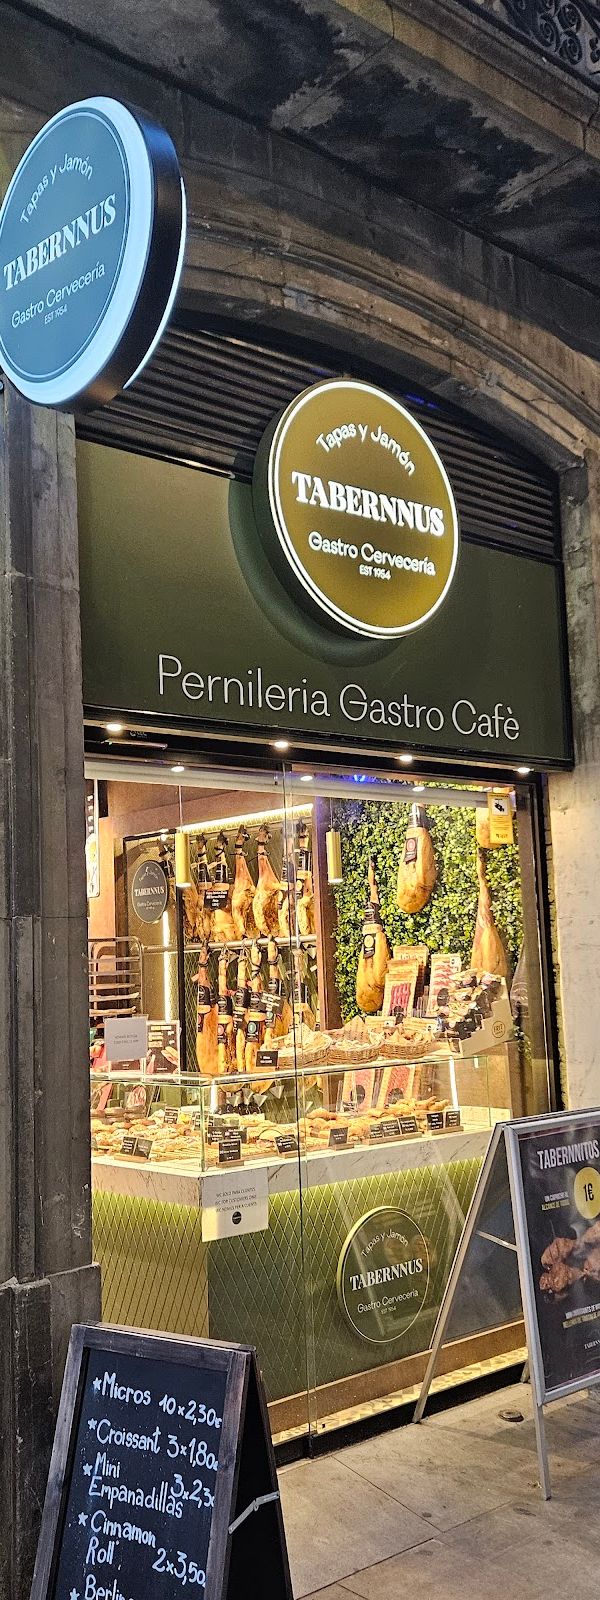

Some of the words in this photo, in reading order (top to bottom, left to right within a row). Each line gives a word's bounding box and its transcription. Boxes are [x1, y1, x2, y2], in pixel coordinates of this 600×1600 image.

[20, 174, 50, 224] Tapas
[50, 164, 59, 185] y
[59, 152, 94, 181] Jamón
[3, 193, 117, 291] TABERNNUS
[11, 300, 44, 328] Gastro
[46, 260, 106, 307] Cervecería
[44, 311, 55, 324] EST
[55, 303, 68, 317] 1954
[316, 423, 356, 453] Tapas
[358, 424, 368, 443] y
[370, 425, 416, 477] Jamón
[291, 470, 445, 537] TABERNNUS
[308, 531, 358, 559] Gastro
[360, 542, 436, 577] Cervecería
[359, 564, 373, 577] EST
[374, 566, 391, 580] 1954
[157, 654, 330, 717] Pernileria
[339, 684, 443, 732] Gastro
[452, 699, 520, 740] Cafè
[537, 1139, 600, 1170] TABERNNITOS
[583, 1182, 595, 1202] 1€
[361, 1235, 380, 1257] Tapas
[380, 1232, 386, 1242] y
[349, 1258, 423, 1292] TABERNNUS
[357, 1301, 381, 1314] Gastro
[102, 1371, 151, 1406] Micros
[96, 1418, 161, 1455] Croissant
[94, 1452, 121, 1479] Mini
[89, 1475, 183, 1519] Empanadillas
[90, 1509, 156, 1549] Cinnamon
[85, 1536, 116, 1566] Roll
